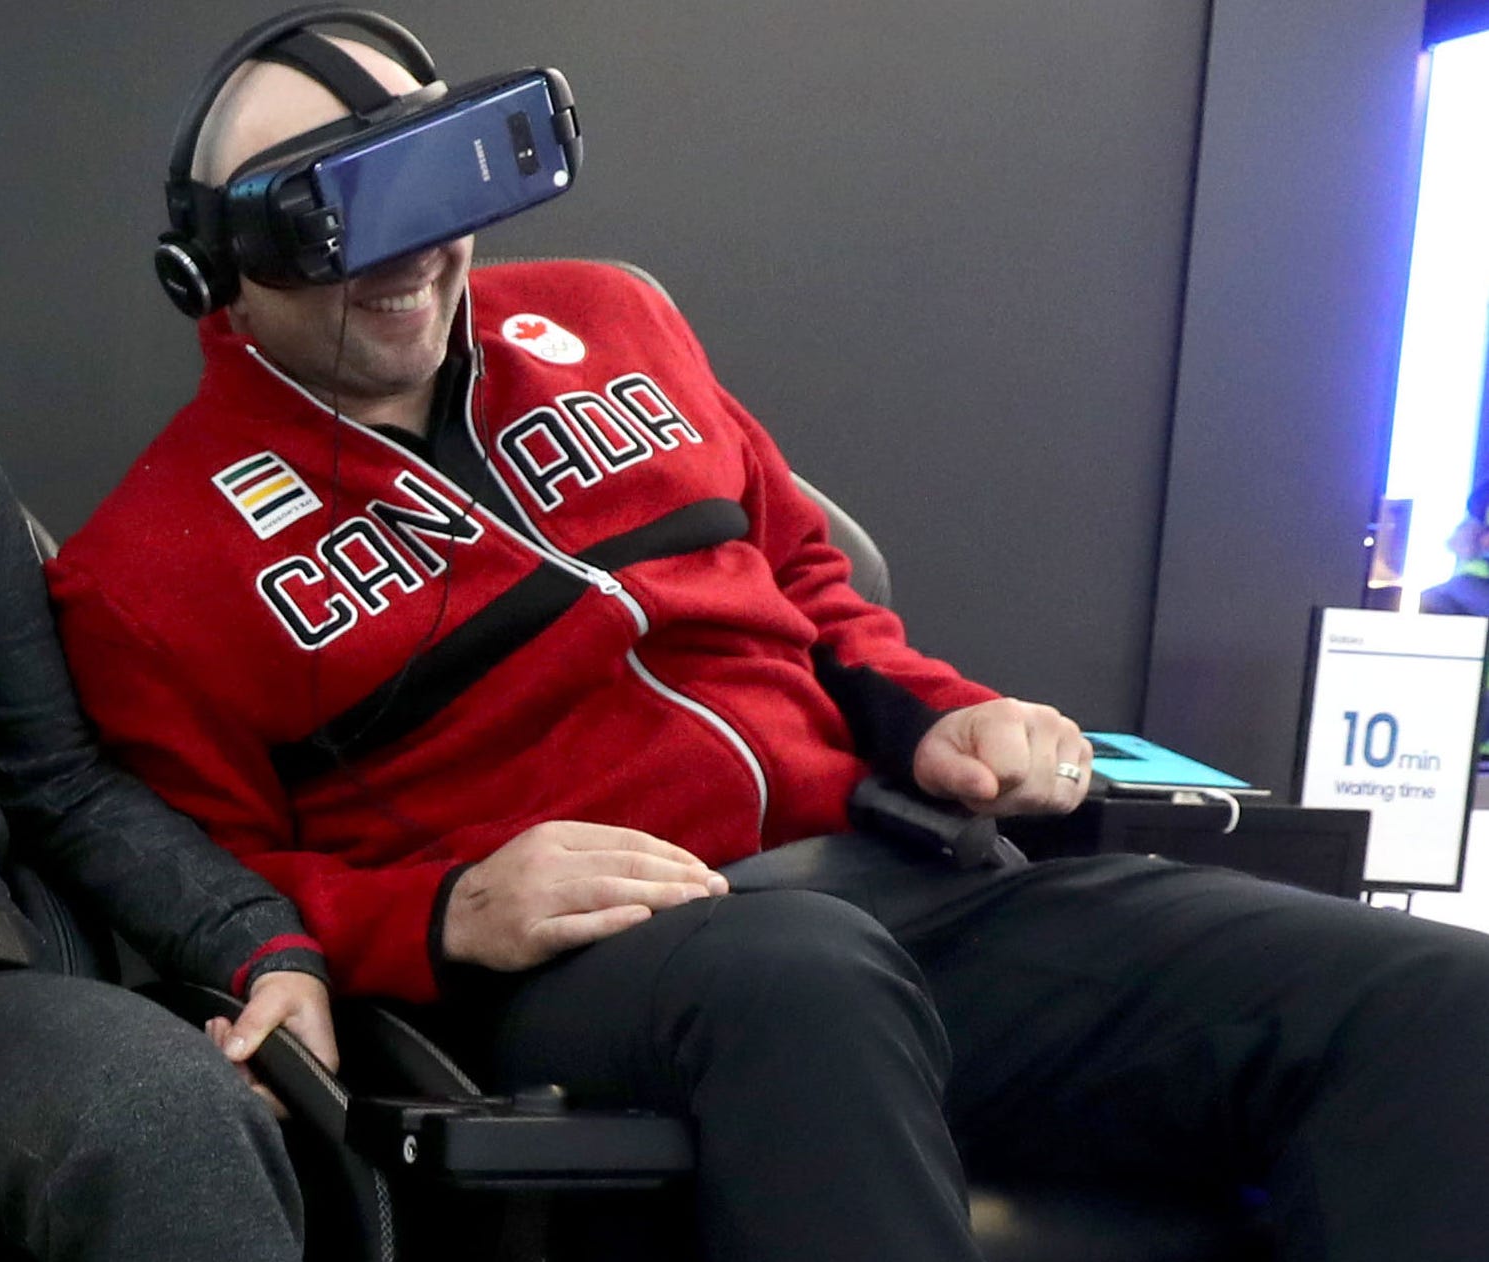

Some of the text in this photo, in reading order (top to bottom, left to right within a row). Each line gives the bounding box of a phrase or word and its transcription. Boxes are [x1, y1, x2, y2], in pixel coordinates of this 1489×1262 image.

[1342, 710, 1441, 771] 10 min
[1334, 780, 1436, 802] Waiting time
